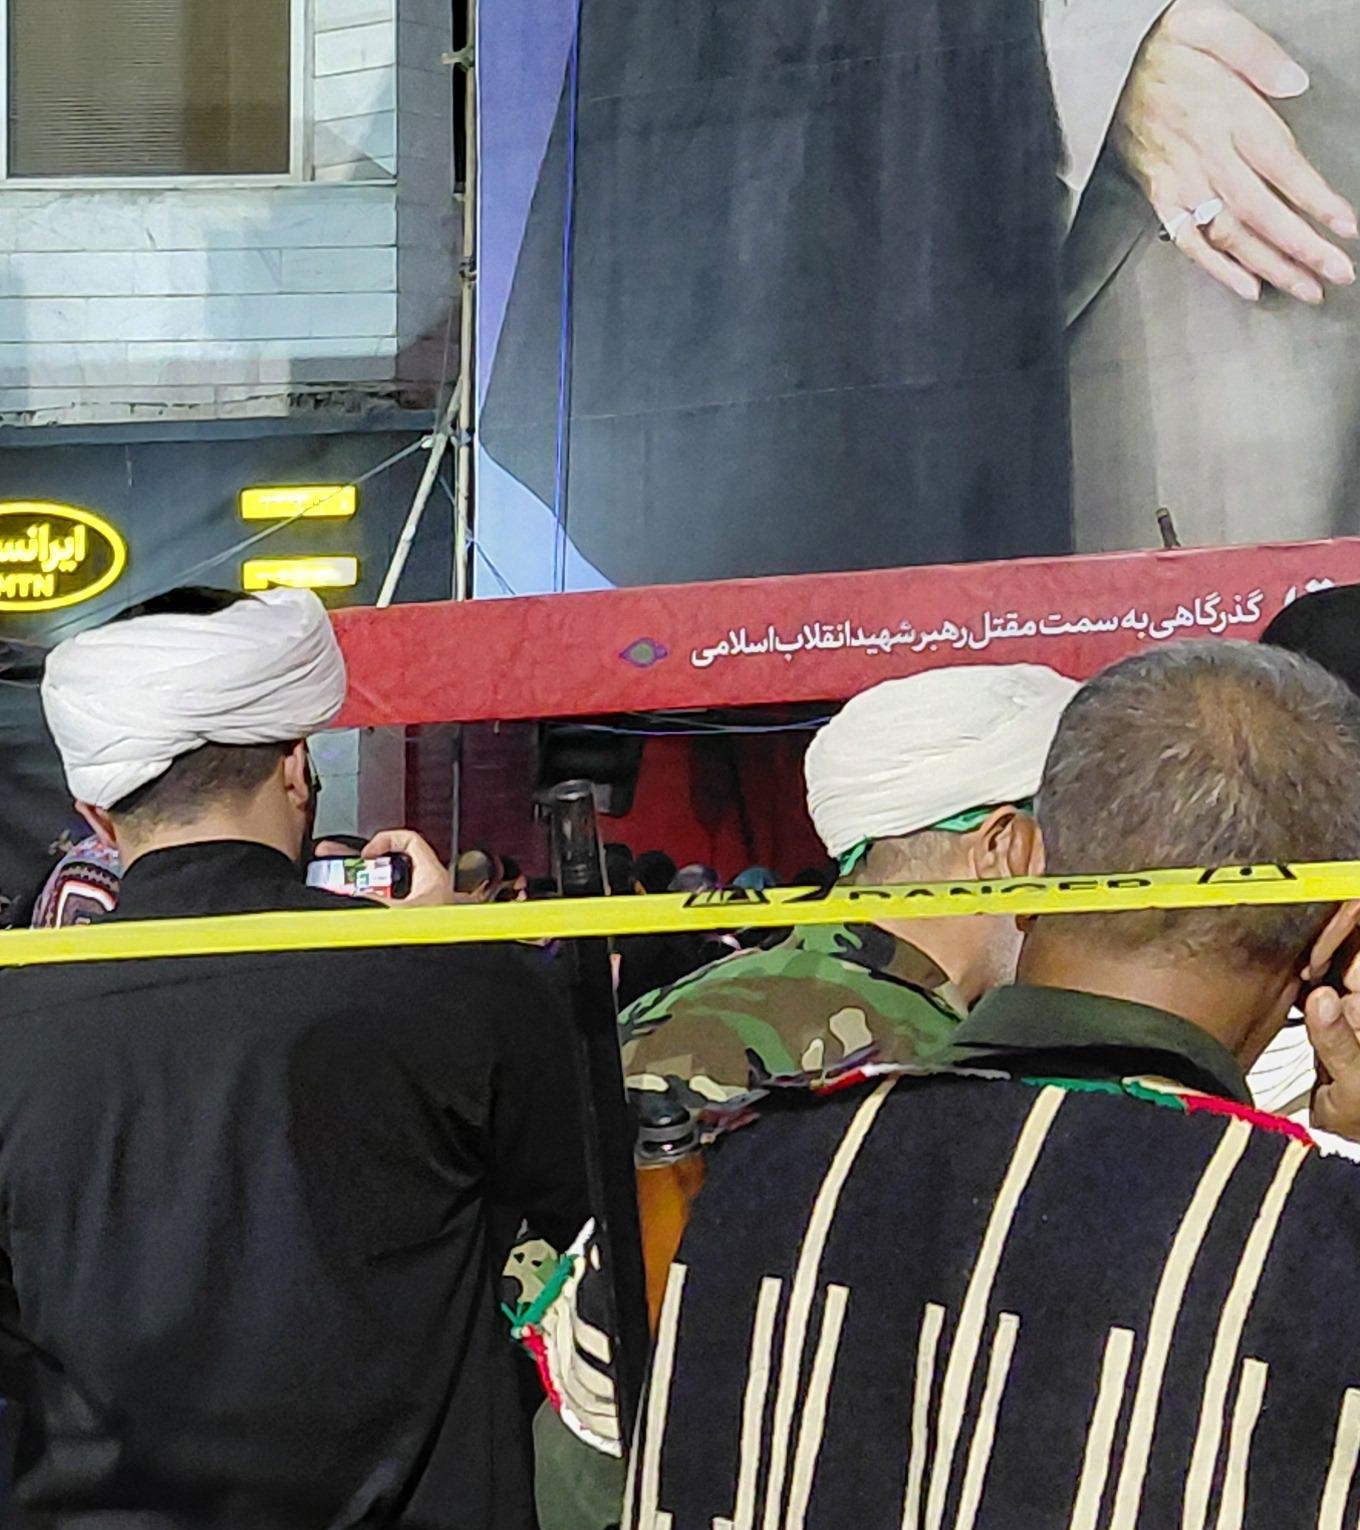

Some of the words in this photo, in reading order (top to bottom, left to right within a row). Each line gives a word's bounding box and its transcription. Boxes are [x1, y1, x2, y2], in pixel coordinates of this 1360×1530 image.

[969, 611, 1037, 649] مقتل
[1038, 612, 1120, 636] سمت
[1120, 609, 1150, 640] به
[1149, 588, 1265, 640] گذرگاهی
[690, 625, 776, 668] اسلامی
[774, 620, 851, 662] انقلاب
[850, 619, 916, 655] شهید
[912, 620, 970, 652] رهبر
